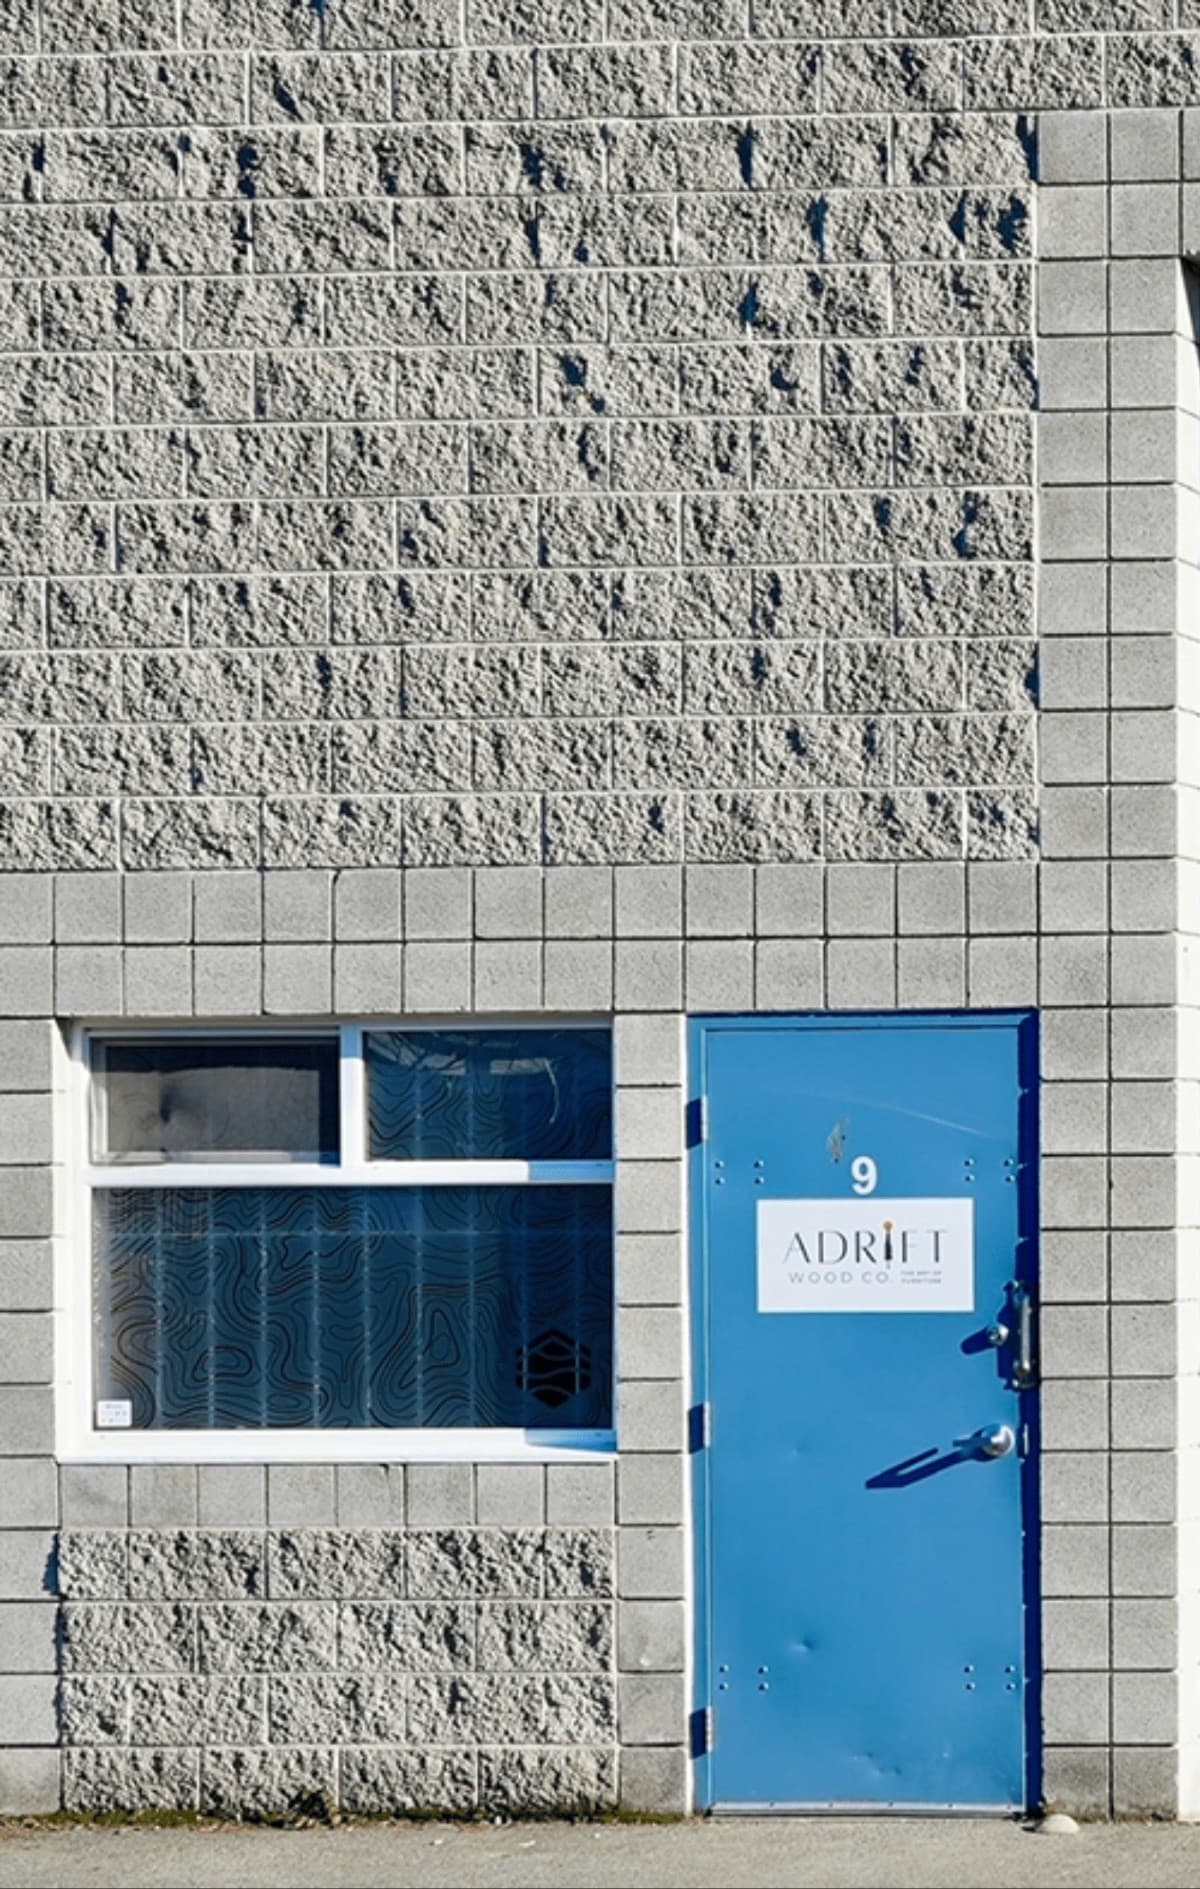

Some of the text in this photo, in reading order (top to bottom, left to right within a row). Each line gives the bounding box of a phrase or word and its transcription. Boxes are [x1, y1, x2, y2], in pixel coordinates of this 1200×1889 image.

[851, 1155, 878, 1196] 9
[782, 1220, 948, 1270] ADRIFT
[788, 1271, 854, 1285] WOOD
